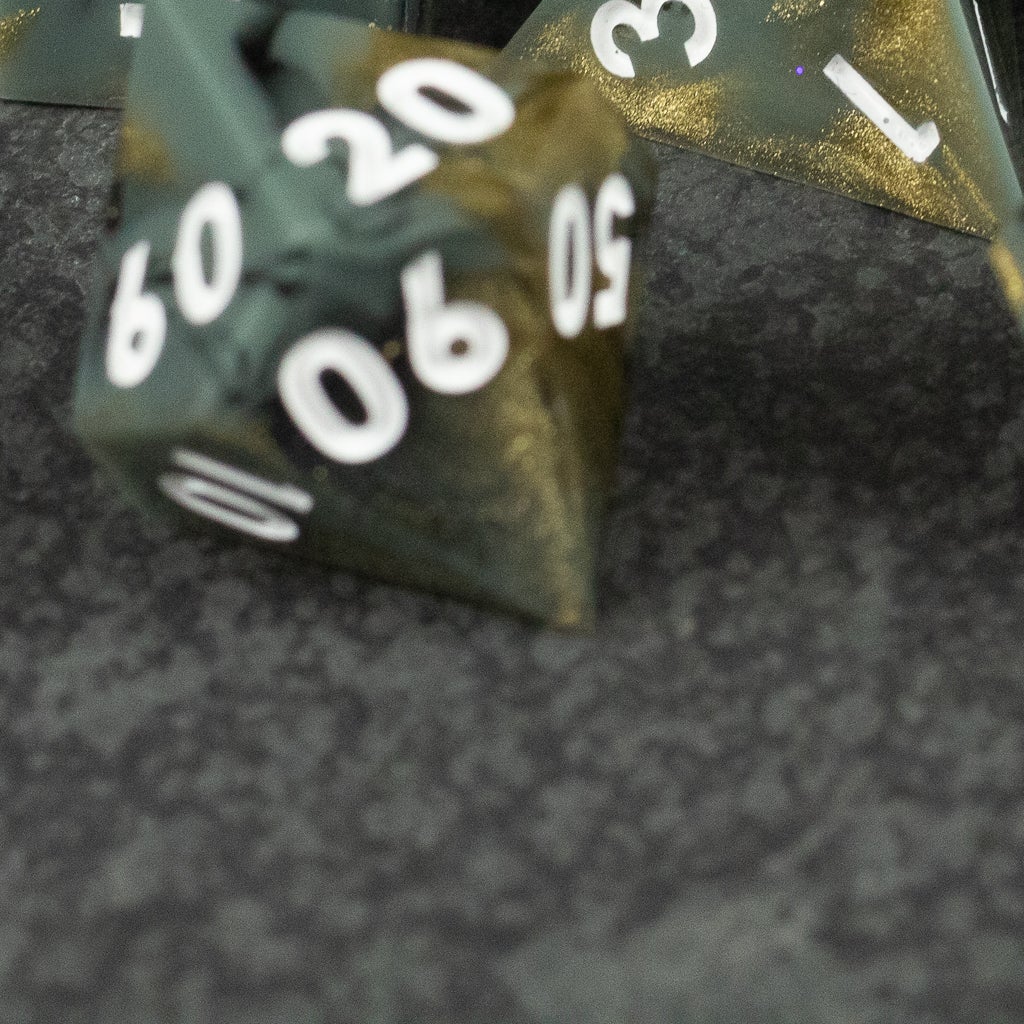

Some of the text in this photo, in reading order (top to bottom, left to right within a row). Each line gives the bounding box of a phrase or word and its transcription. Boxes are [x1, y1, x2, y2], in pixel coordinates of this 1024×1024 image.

[280, 57, 517, 207] 20
[823, 54, 941, 163] 1
[547, 174, 637, 340] 50
